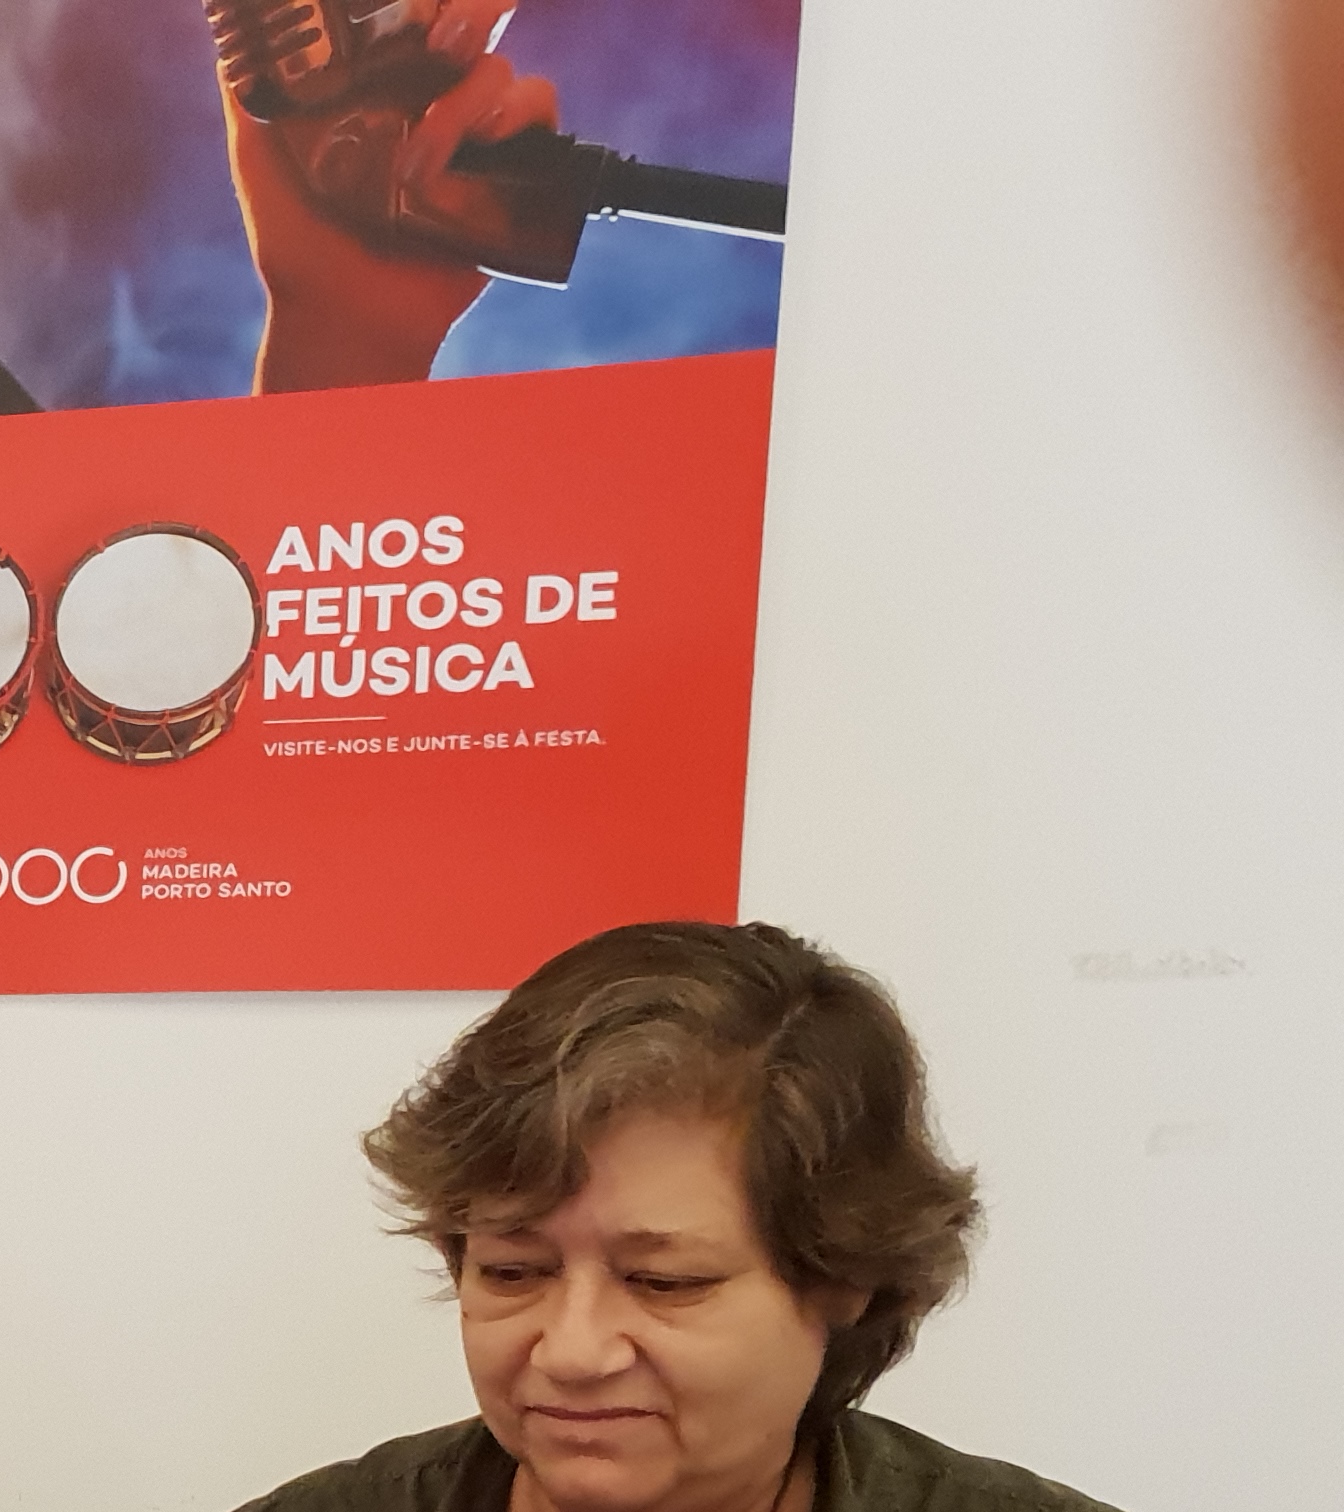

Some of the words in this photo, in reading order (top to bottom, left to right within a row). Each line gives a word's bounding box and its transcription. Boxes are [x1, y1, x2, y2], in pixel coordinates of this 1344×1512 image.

[266, 515, 464, 574] ANOS
[266, 577, 503, 637] FEITOS
[525, 571, 619, 624] DE
[264, 634, 535, 700] MÚSICA
[264, 738, 381, 757] VISITE-NOS
[386, 736, 399, 752] E
[403, 733, 509, 752] JUNTE-SE
[514, 728, 529, 748] À
[143, 846, 188, 859] ANOS
[142, 862, 238, 880] MADEIRA
[142, 884, 212, 899] PORTO
[218, 880, 292, 898] SANTO
